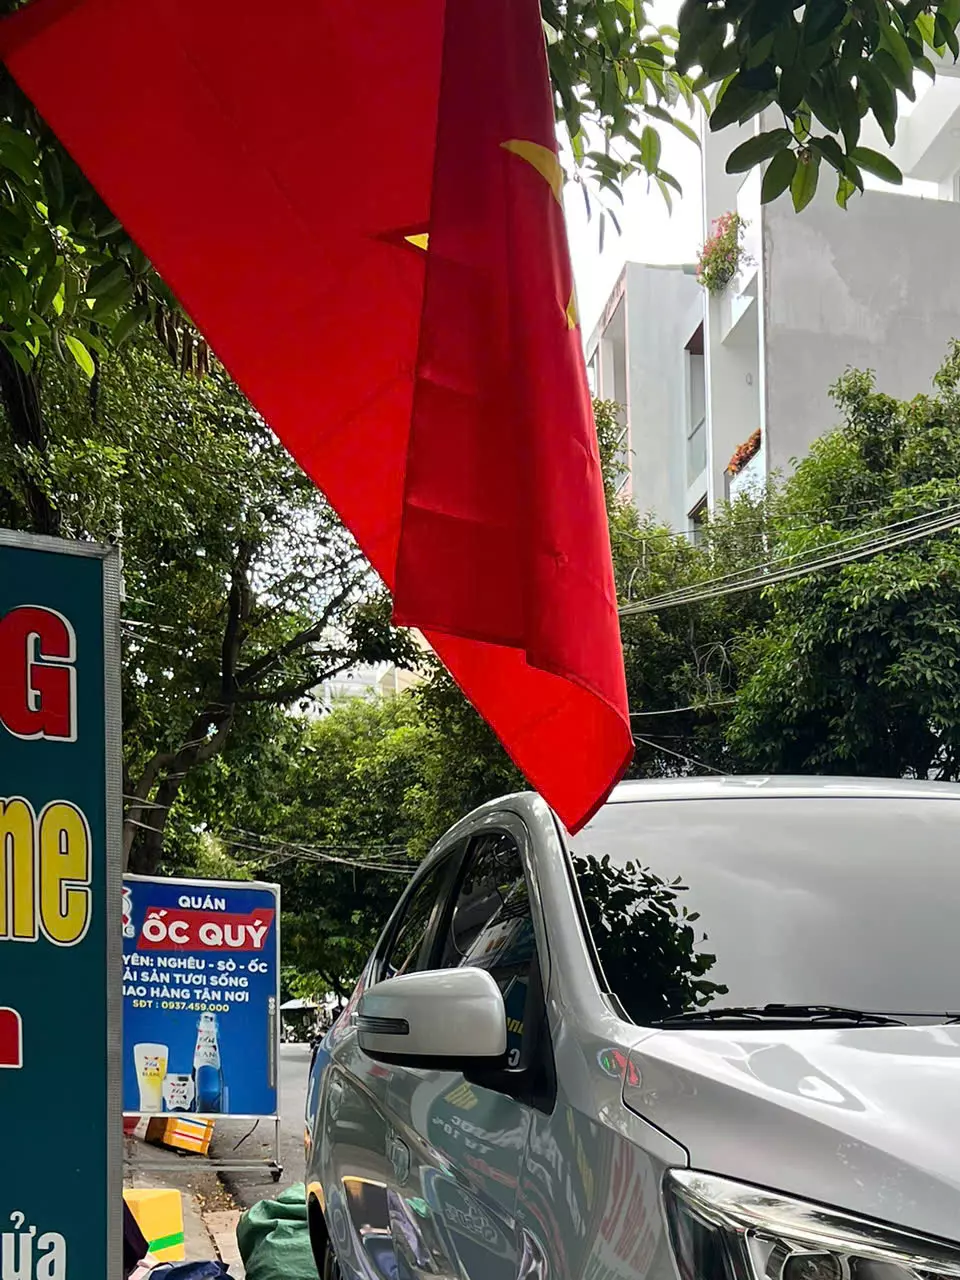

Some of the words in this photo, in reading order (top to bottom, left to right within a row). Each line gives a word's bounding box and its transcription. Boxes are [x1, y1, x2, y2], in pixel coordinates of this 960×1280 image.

[0, 604, 77, 742] G
[178, 895, 226, 910] QUÁN
[142, 910, 190, 944] ỐC
[199, 920, 268, 948] QUÝ
[157, 956, 205, 970] NGHÊU
[217, 959, 236, 972] SÒ
[247, 958, 268, 973] ỐC
[140, 968, 170, 984] SẢN
[173, 972, 207, 986] TƯƠI
[209, 972, 249, 987] SỐNG
[150, 985, 190, 999] HÀNG
[193, 987, 222, 1003] TẬN
[225, 990, 249, 1002] NƠI
[132, 1000, 153, 1008] SĐT
